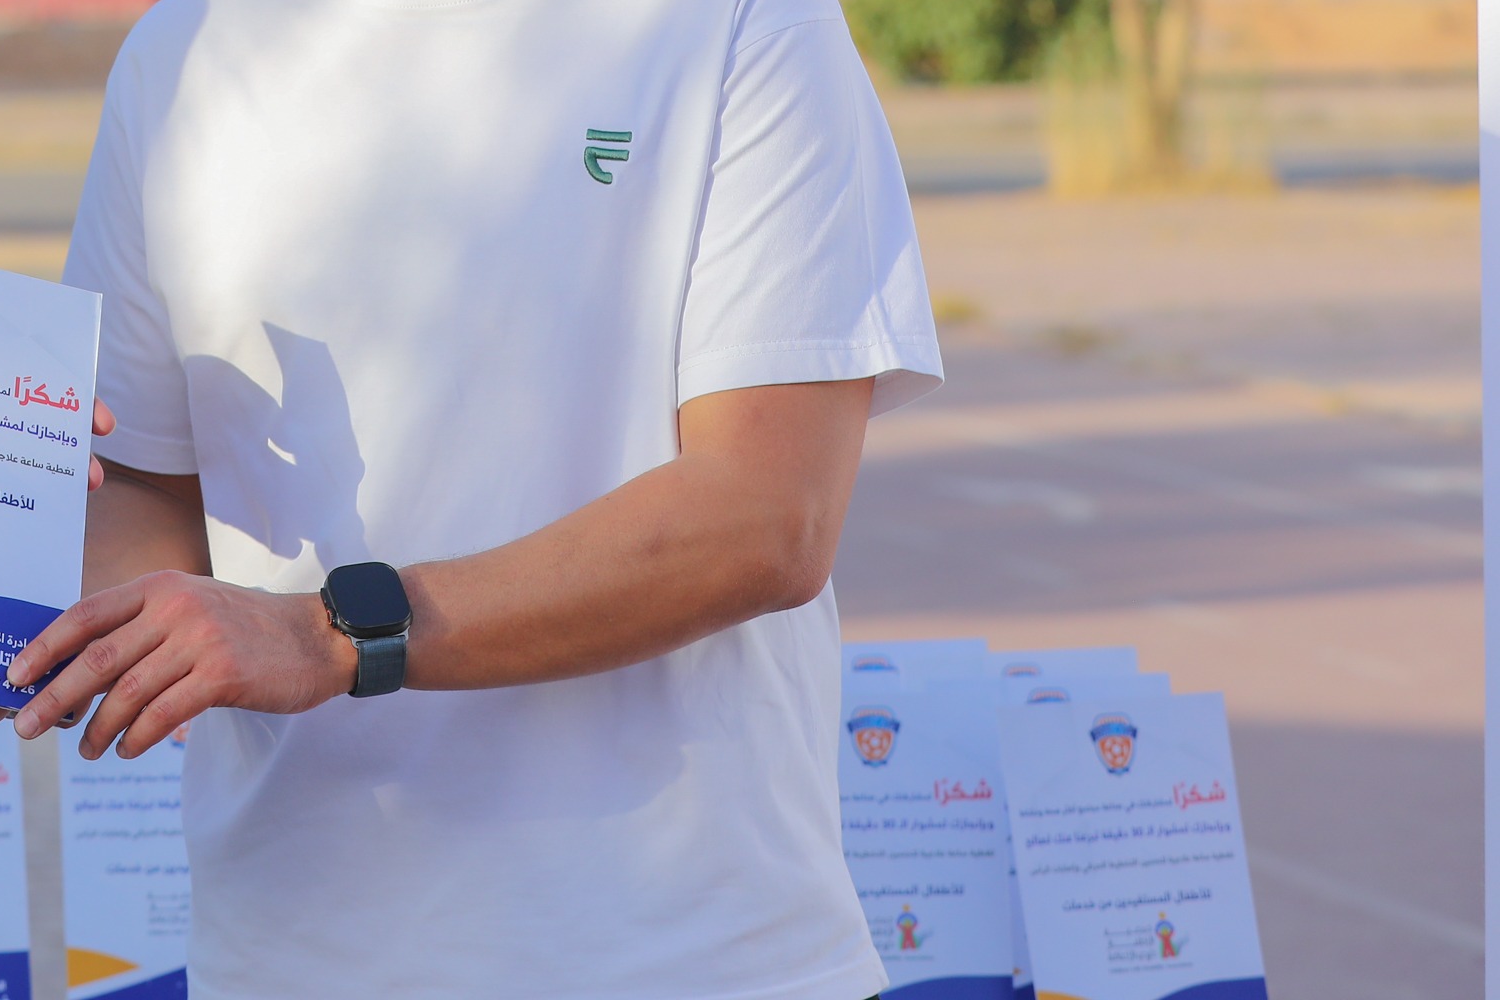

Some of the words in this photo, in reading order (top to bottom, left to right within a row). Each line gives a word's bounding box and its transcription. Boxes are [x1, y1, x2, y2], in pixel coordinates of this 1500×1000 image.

[27, 424, 78, 447] وبإنجازك
[20, 456, 44, 469] ساعة
[45, 463, 75, 477] تغطية
